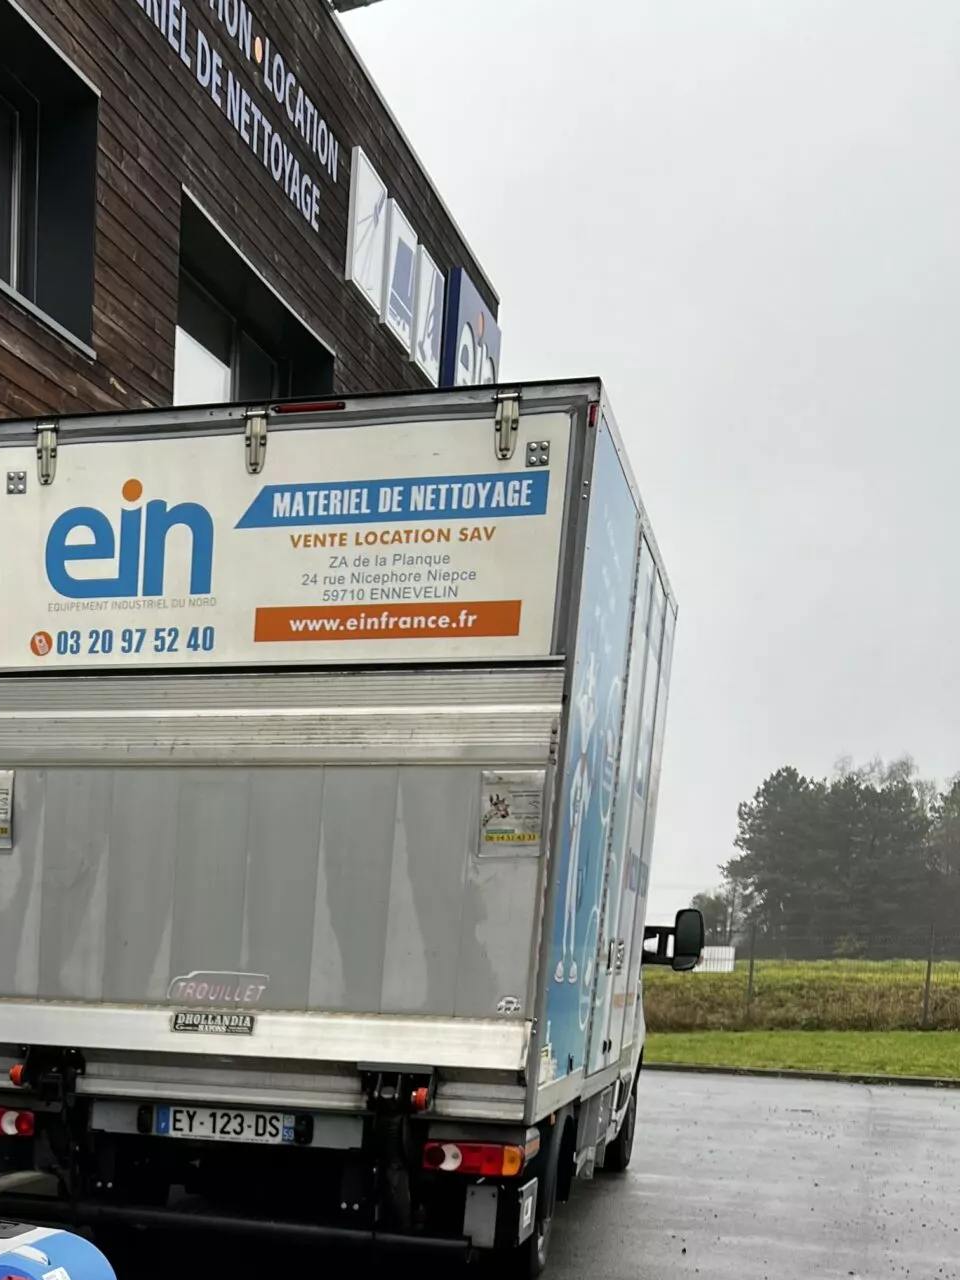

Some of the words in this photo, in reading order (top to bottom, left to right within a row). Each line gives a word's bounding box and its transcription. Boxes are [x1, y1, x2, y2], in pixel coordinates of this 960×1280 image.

[264, 36, 339, 184] LOCATION
[196, 29, 223, 108] DE
[227, 70, 321, 233] NETTOYAGE
[272, 488, 371, 518] MATERIEL
[378, 486, 404, 513] DE
[409, 479, 533, 512] NETTOYAGE
[45, 478, 215, 599] ein
[290, 531, 348, 549] VENTE
[354, 527, 451, 547] LOCATION
[458, 526, 497, 542] SAV
[328, 556, 348, 569] ZA
[352, 555, 370, 568] de
[374, 554, 388, 567] la
[392, 553, 451, 568] Planque
[301, 574, 318, 586] 24
[323, 574, 346, 586] rue
[350, 570, 422, 587] Nicephore
[427, 570, 477, 585] Niepce
[48, 600, 109, 612] EQUIPEMENT
[111, 599, 169, 610] INDUSTRIEL
[171, 598, 186, 609] DU
[188, 597, 218, 608] NORD
[322, 588, 365, 602] 59710
[370, 586, 459, 601] ENNEVELIN
[289, 610, 478, 632] www.einfrance.fr
[56, 630, 81, 656] 03
[88, 629, 114, 655] 20
[121, 628, 147, 654] 97
[154, 627, 180, 653] 52
[186, 626, 215, 652] 40
[176, 981, 267, 1002] TROUILLET
[176, 1013, 252, 1027] DHOLLANDIA
[172, 1109, 281, 1138] EY-123-DS
[283, 1129, 295, 1141] 59
